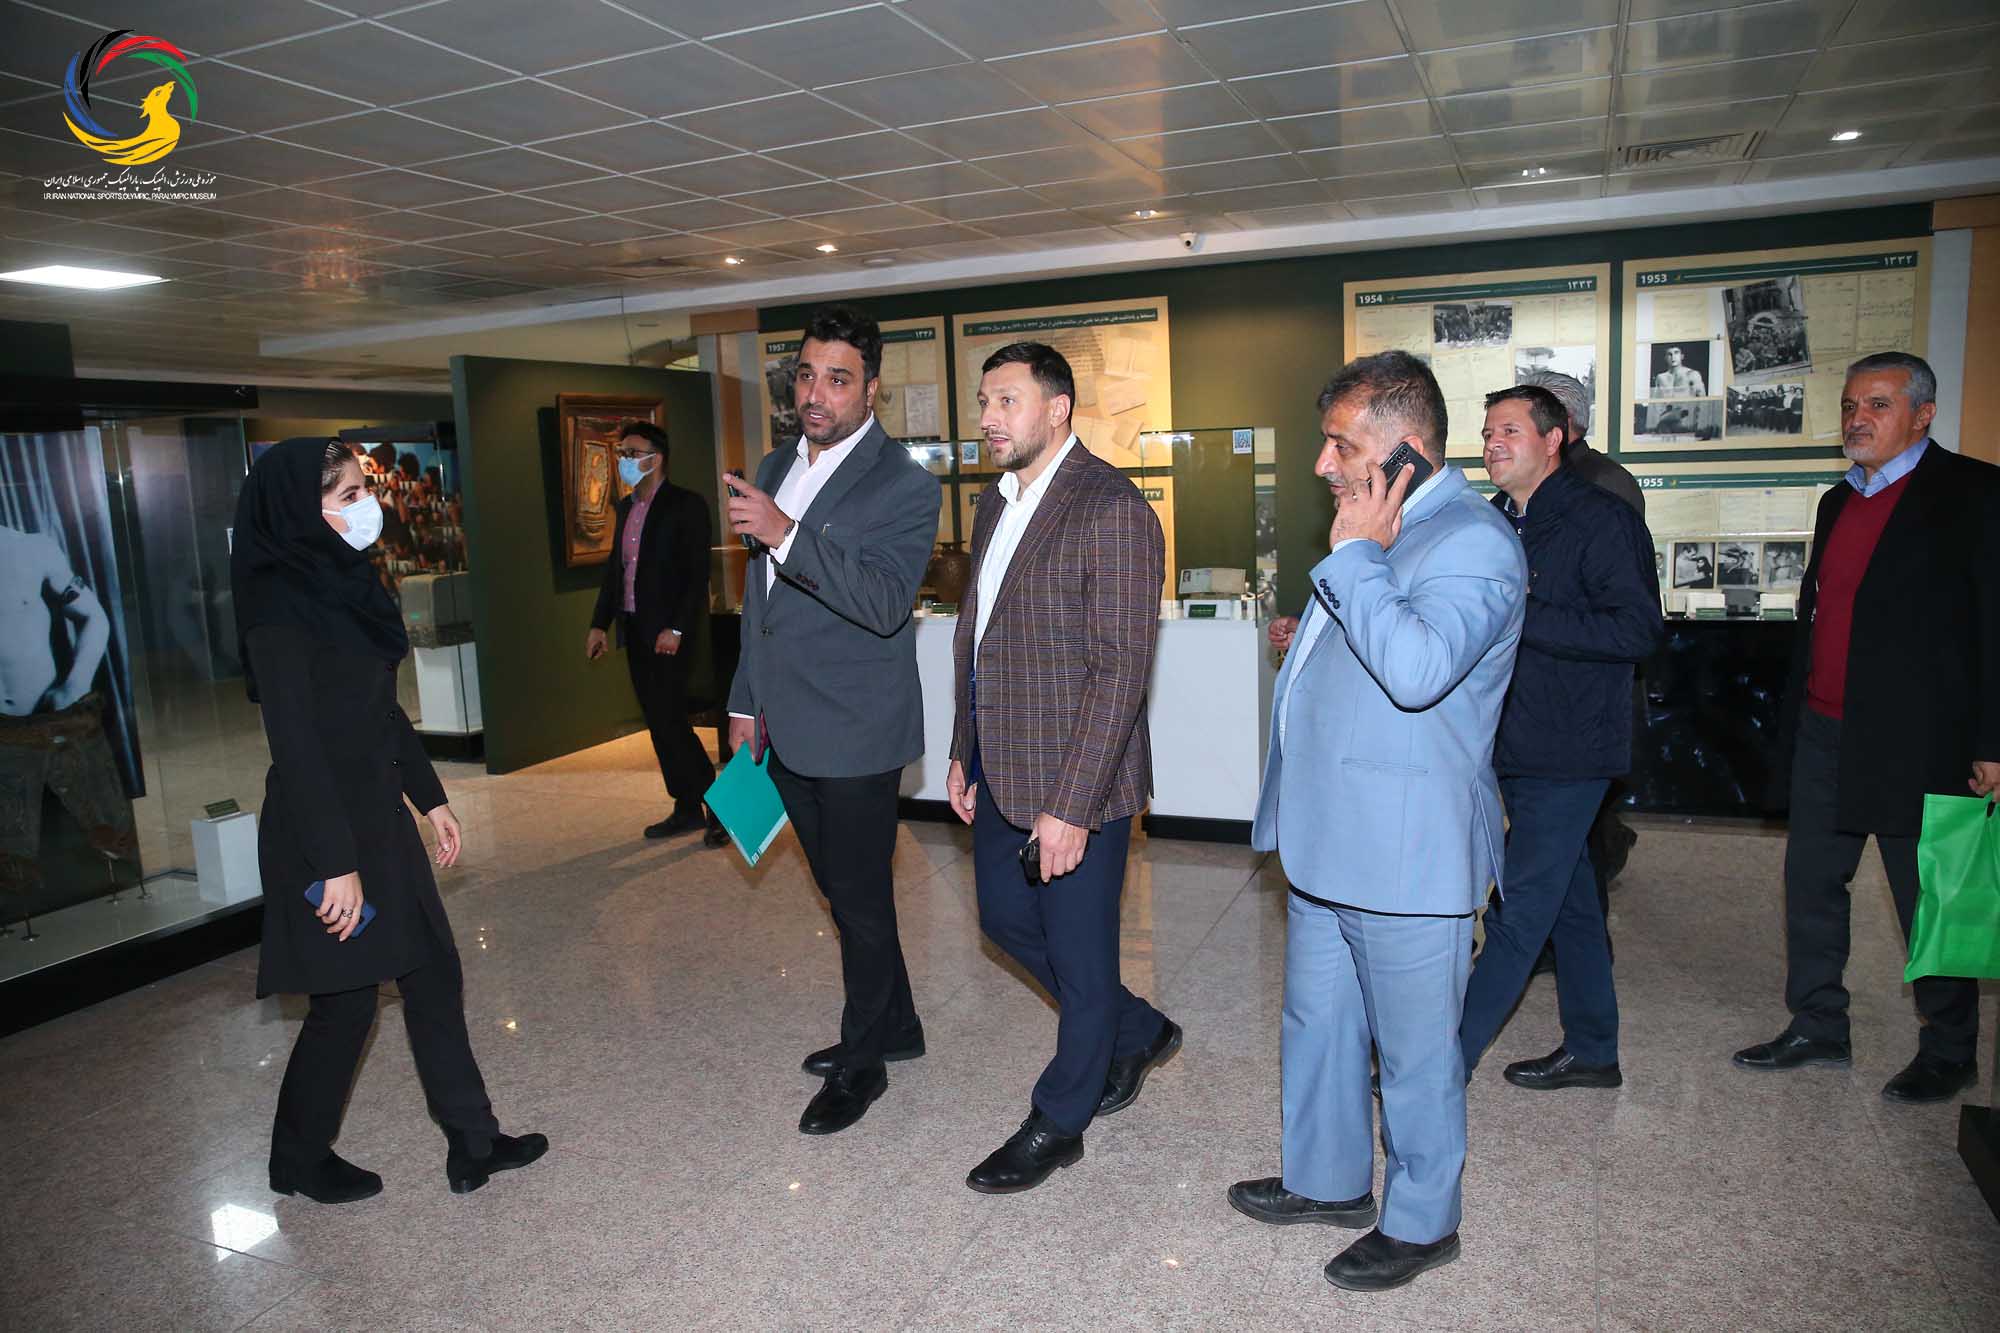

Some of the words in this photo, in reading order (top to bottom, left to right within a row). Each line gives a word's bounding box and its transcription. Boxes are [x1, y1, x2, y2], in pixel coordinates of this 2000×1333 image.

[1640, 273, 1667, 284] 1953
[1359, 294, 1382, 304] 1954
[768, 343, 785, 352] 1957
[1637, 478, 1663, 488] 1955
